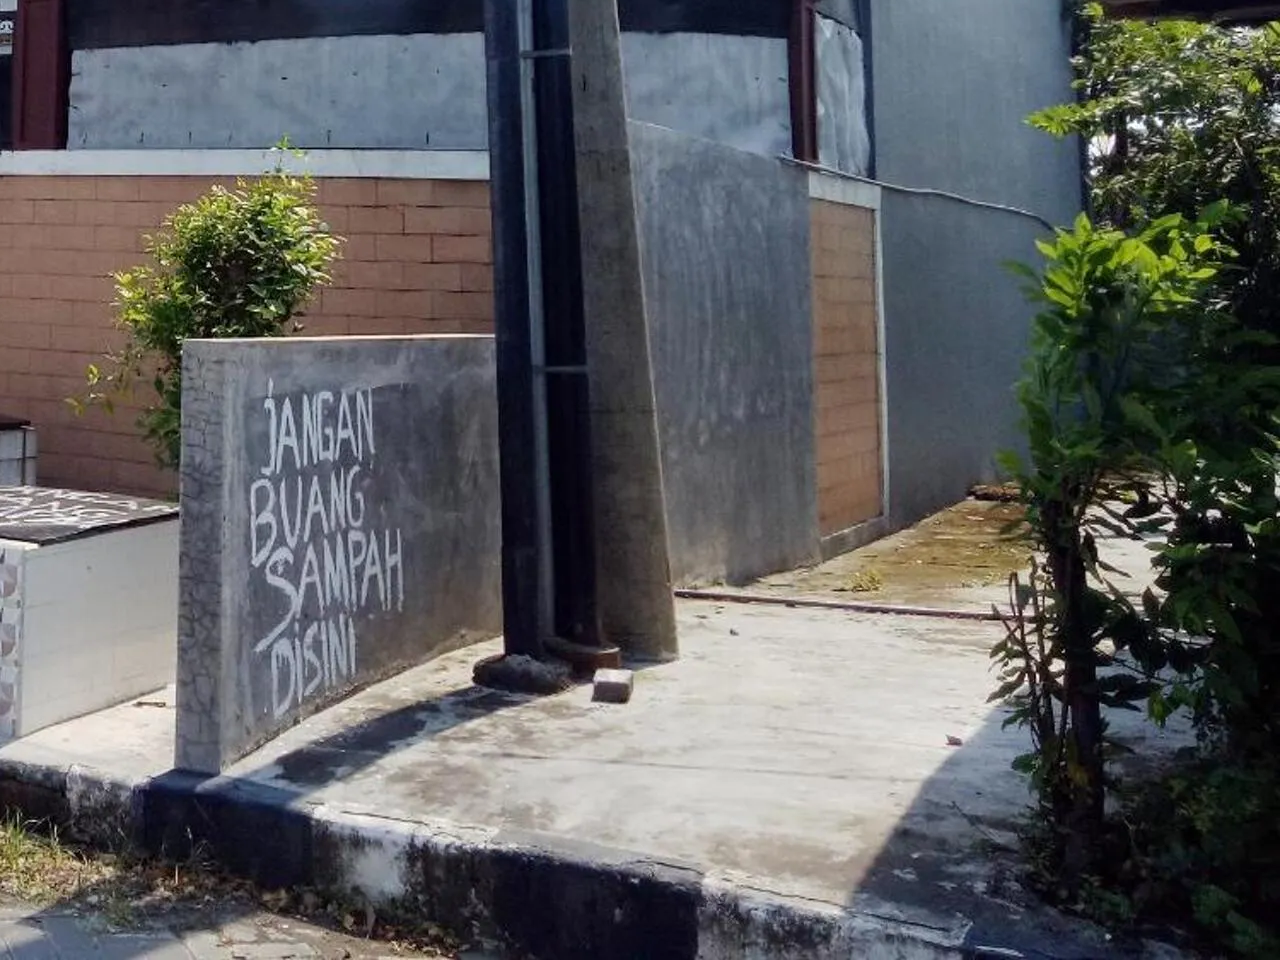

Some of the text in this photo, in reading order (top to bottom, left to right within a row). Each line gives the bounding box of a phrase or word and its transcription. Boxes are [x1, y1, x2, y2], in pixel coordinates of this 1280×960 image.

[261, 378, 375, 476] JANGAN
[250, 465, 365, 567] BUANG
[253, 528, 404, 652] SAMPAH
